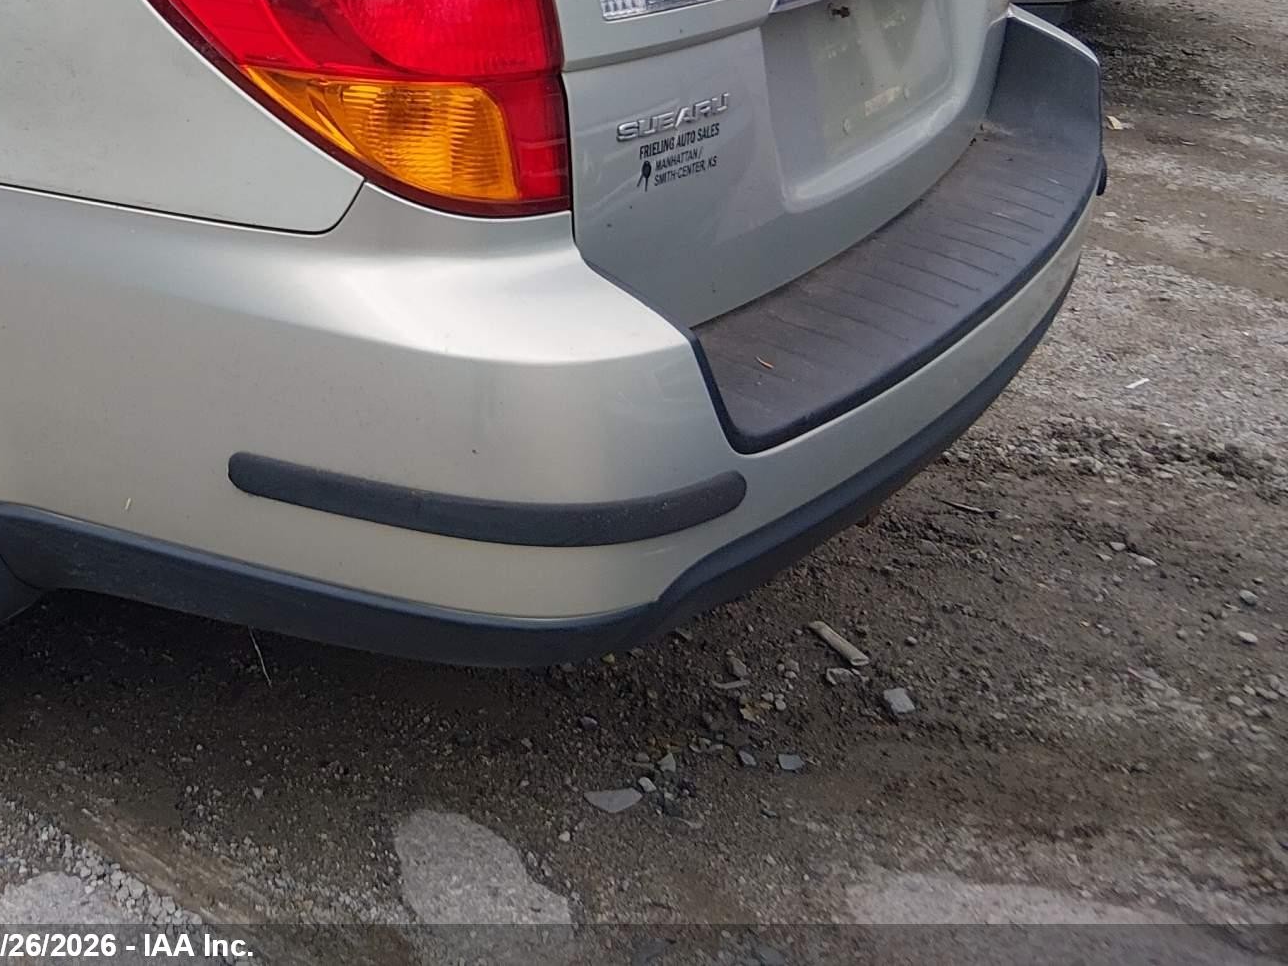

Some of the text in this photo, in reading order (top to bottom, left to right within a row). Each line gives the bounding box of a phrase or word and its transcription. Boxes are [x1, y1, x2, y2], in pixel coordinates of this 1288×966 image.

[616, 93, 730, 143] SUBARU
[639, 123, 720, 160] FRIELING AUTO SALES
